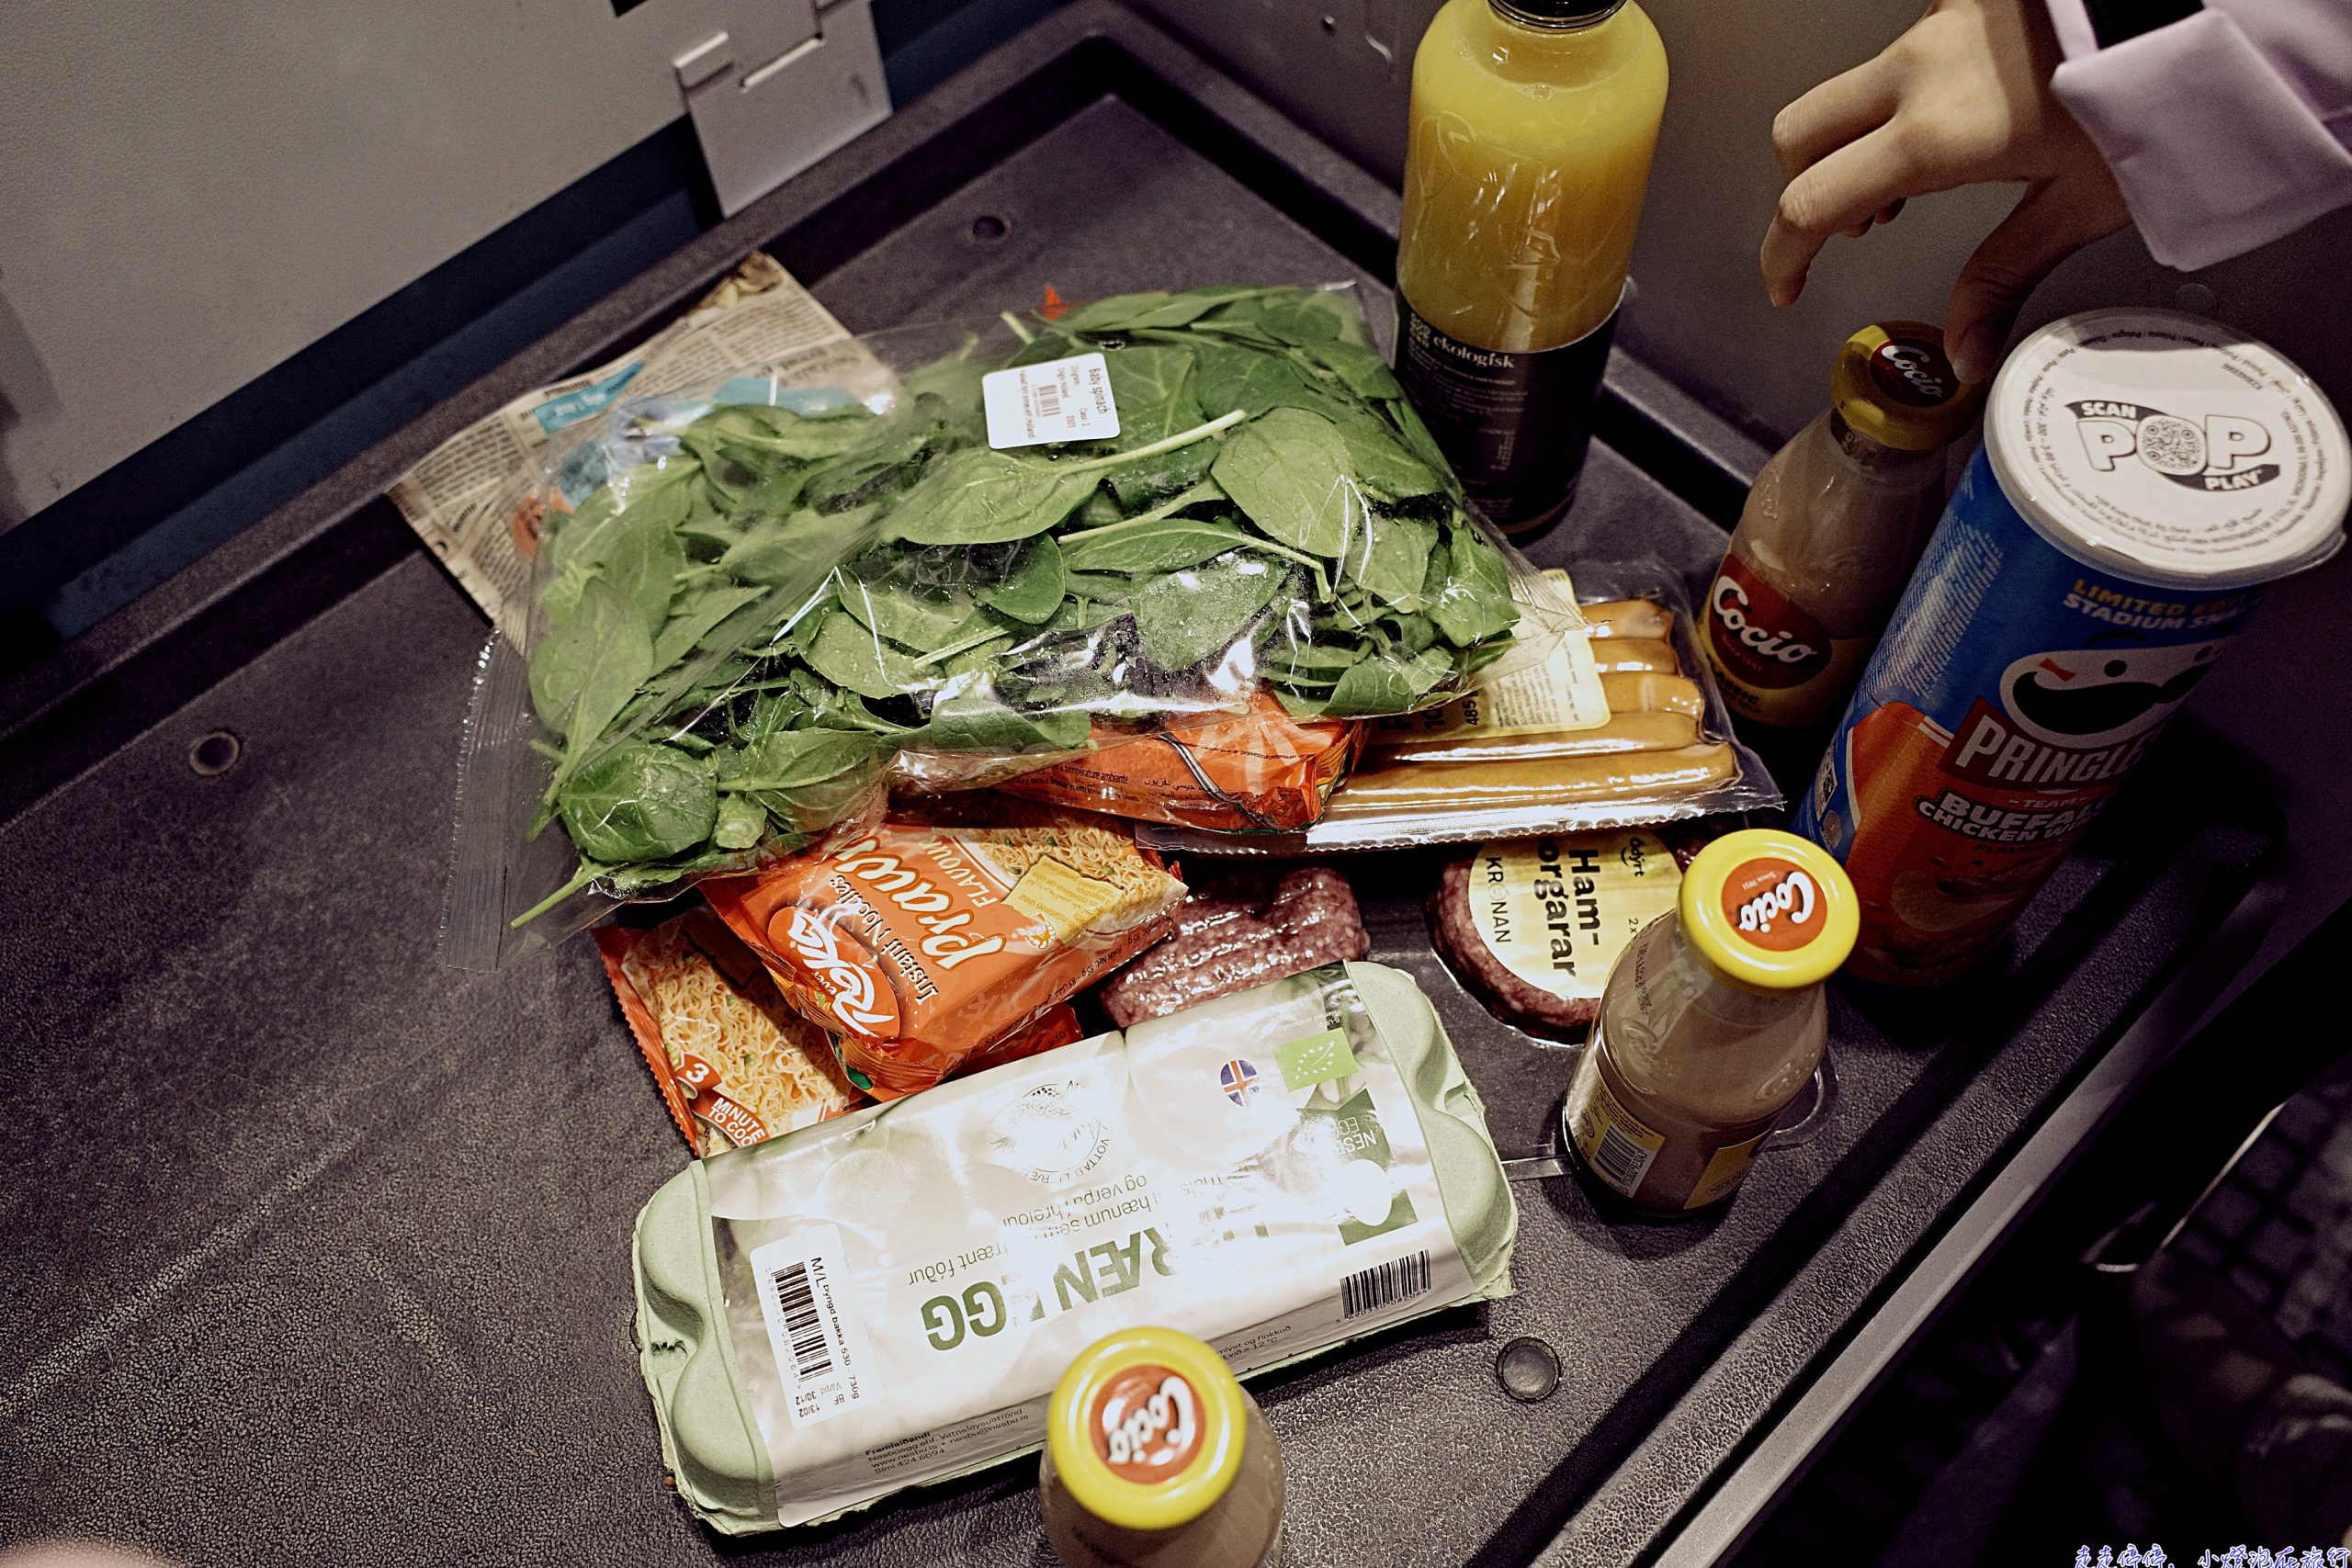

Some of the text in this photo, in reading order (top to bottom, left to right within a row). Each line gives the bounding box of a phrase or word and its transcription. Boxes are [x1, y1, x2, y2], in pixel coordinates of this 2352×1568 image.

[1882, 345, 1942, 397] Cocio
[1089, 367, 1111, 414] Baby spinach
[2081, 402, 2137, 419] SCAN
[2205, 469, 2259, 491] PLAY
[2064, 593, 2186, 629] STADIUM
[2072, 578, 2187, 615] LIMITED
[1713, 576, 1819, 664] Cocio
[1463, 700, 1479, 726] 485
[1101, 770, 1129, 784] ambiante
[2023, 796, 2075, 808] TEAM
[1918, 801, 2039, 841] CHICKEN
[1533, 837, 1577, 977] orgarar
[1568, 849, 1601, 945] Ham-
[1739, 871, 1815, 933] Cocio
[830, 875, 940, 1005] Instant Noodles
[685, 1062, 709, 1083] 3
[708, 1107, 726, 1124] TO
[726, 1120, 754, 1146] COO
[713, 1097, 765, 1145] MINUTE
[1123, 1170, 1148, 1192] og
[1082, 1196, 1151, 1227] hænum
[904, 1258, 956, 1288] fóður
[916, 1223, 1182, 1353] RÆN GG
[831, 1315, 846, 1346] bakka
[1257, 1325, 1291, 1340] flokkuð
[840, 1347, 852, 1366] 530
[794, 1391, 818, 1404] 30/12
[845, 1374, 861, 1400] 730g
[797, 1393, 844, 1417] BF 13/02
[1108, 1376, 1195, 1464] Cocio
[896, 1456, 917, 1467] 424
[918, 1447, 944, 1461] 6594
